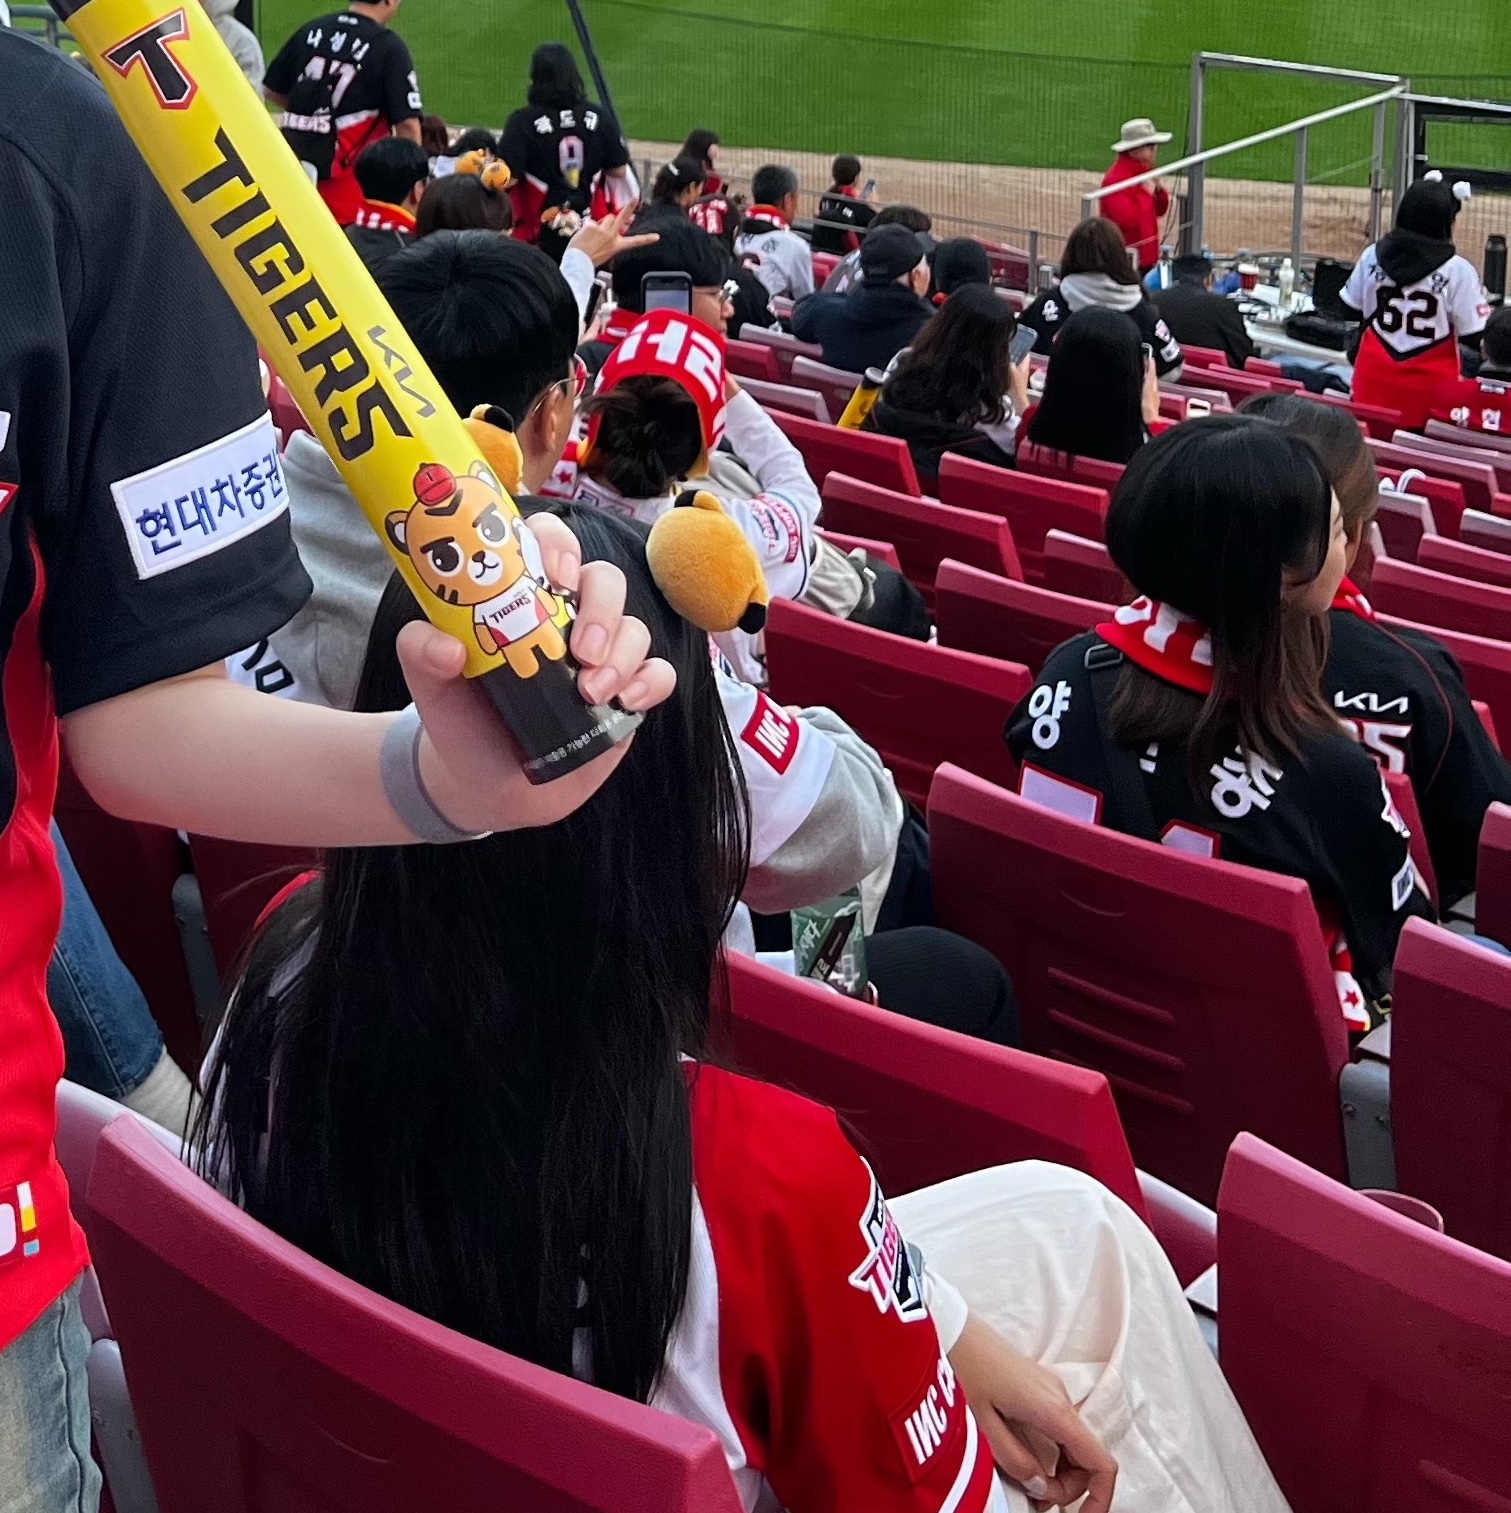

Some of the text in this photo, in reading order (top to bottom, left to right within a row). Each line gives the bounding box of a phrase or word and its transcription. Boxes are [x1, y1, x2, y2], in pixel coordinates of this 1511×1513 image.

[100, 7, 199, 111] T
[181, 124, 414, 463] TIGERS
[1375, 285, 1439, 339] 62
[135, 447, 284, 556] 현대차증권
[488, 593, 532, 625] TIGERS
